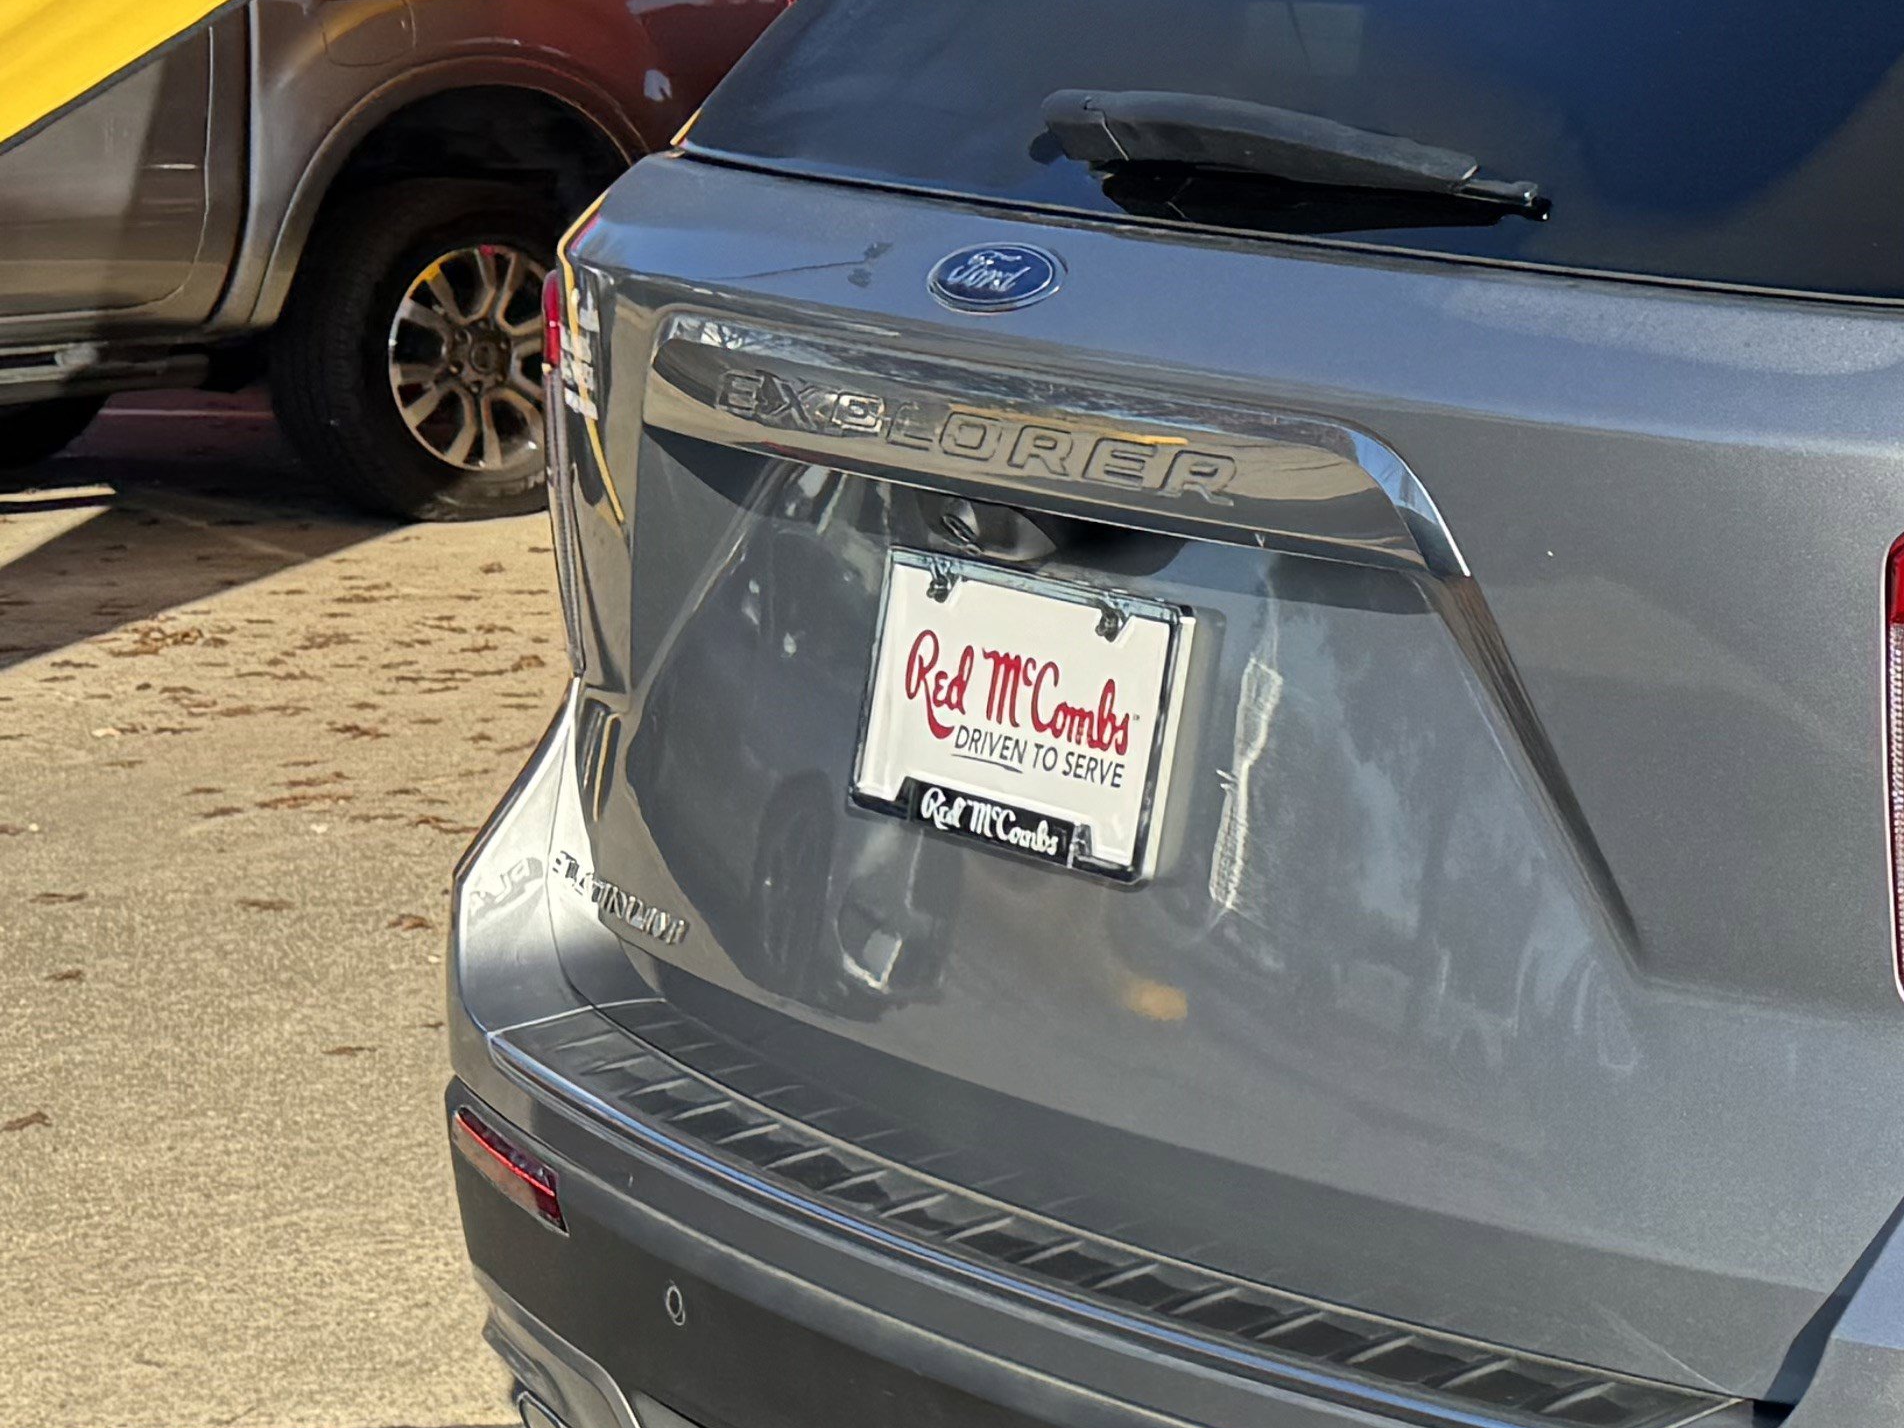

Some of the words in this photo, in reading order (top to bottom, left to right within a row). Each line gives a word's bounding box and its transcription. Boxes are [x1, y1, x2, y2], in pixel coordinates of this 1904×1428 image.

[946, 249, 1032, 293] Ford
[714, 368, 1238, 508] EXPLORER
[904, 629, 975, 740] Red
[981, 646, 1131, 756] McCombs
[953, 724, 1029, 766] DRIVEN
[1032, 743, 1059, 774] TO
[1062, 752, 1126, 789] SERVE
[920, 787, 964, 831] Red
[966, 799, 1060, 857] McCombs
